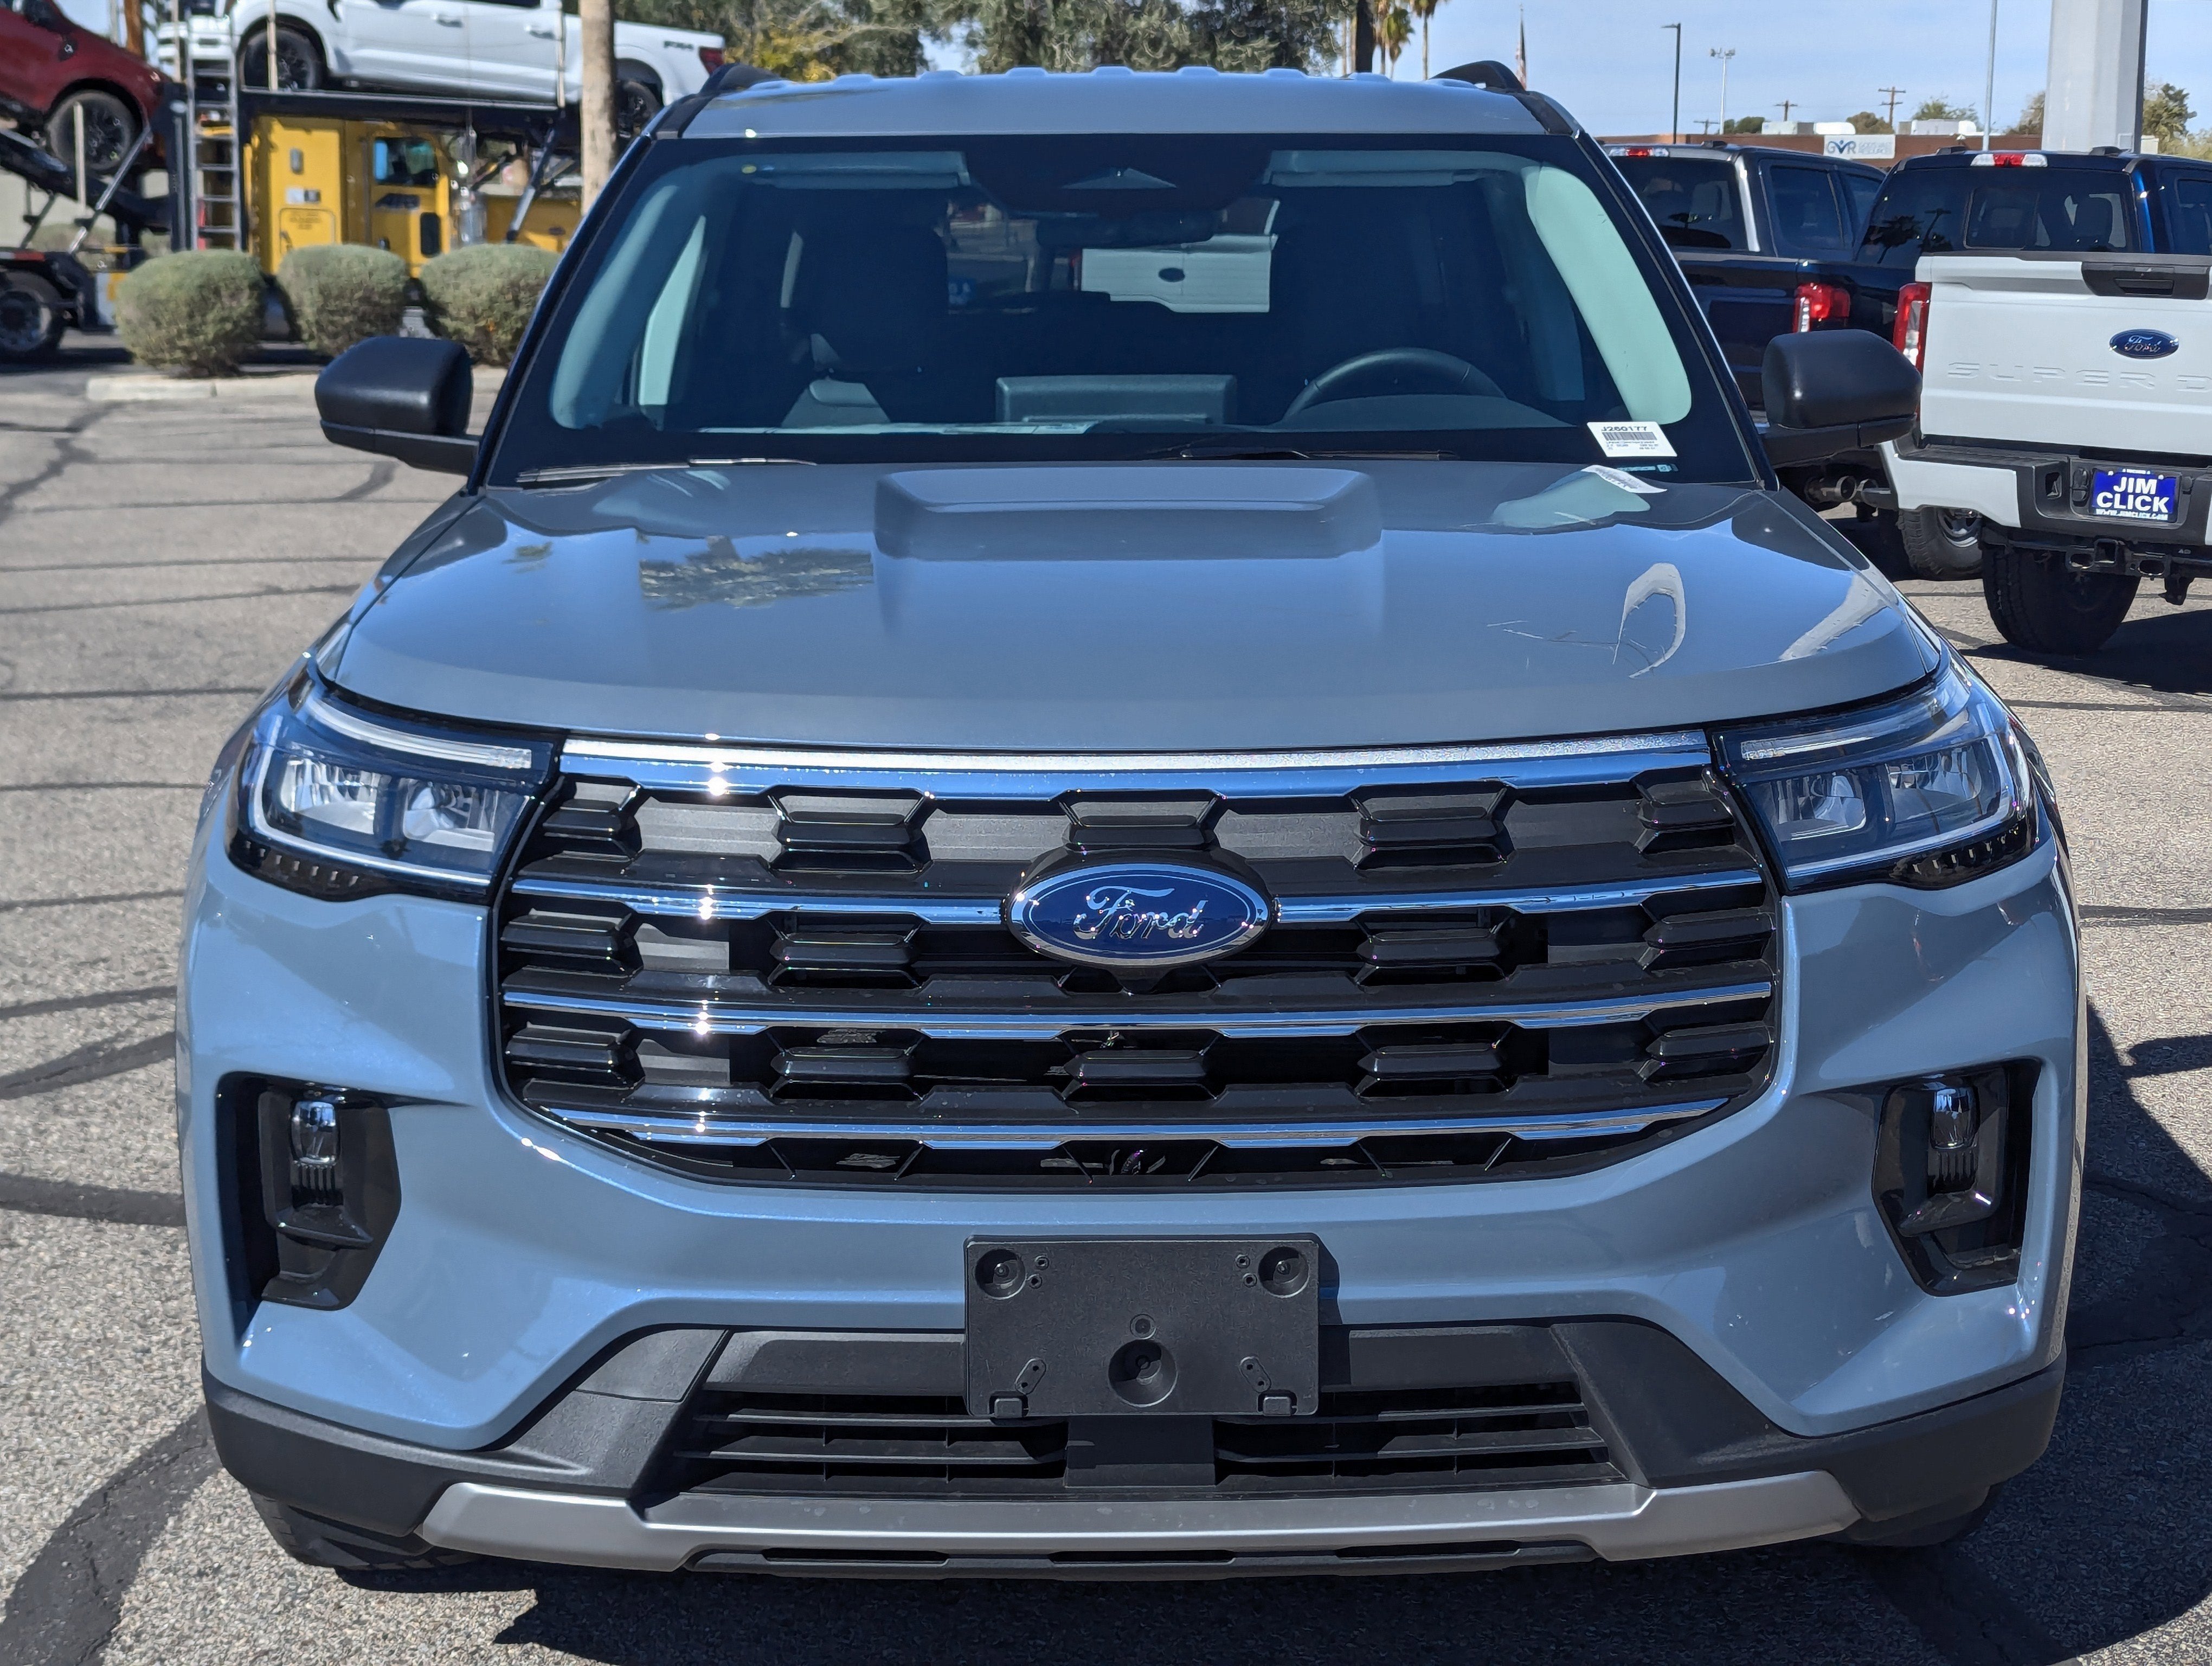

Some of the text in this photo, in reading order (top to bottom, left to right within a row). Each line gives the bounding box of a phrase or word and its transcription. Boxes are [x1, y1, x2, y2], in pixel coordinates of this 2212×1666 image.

[2124, 335, 2162, 353] Ford
[1948, 362, 2156, 390] SUPER
[2113, 477, 2157, 495] JIM
[2097, 491, 2169, 513] CLICK
[1073, 885, 1209, 940] Ford
